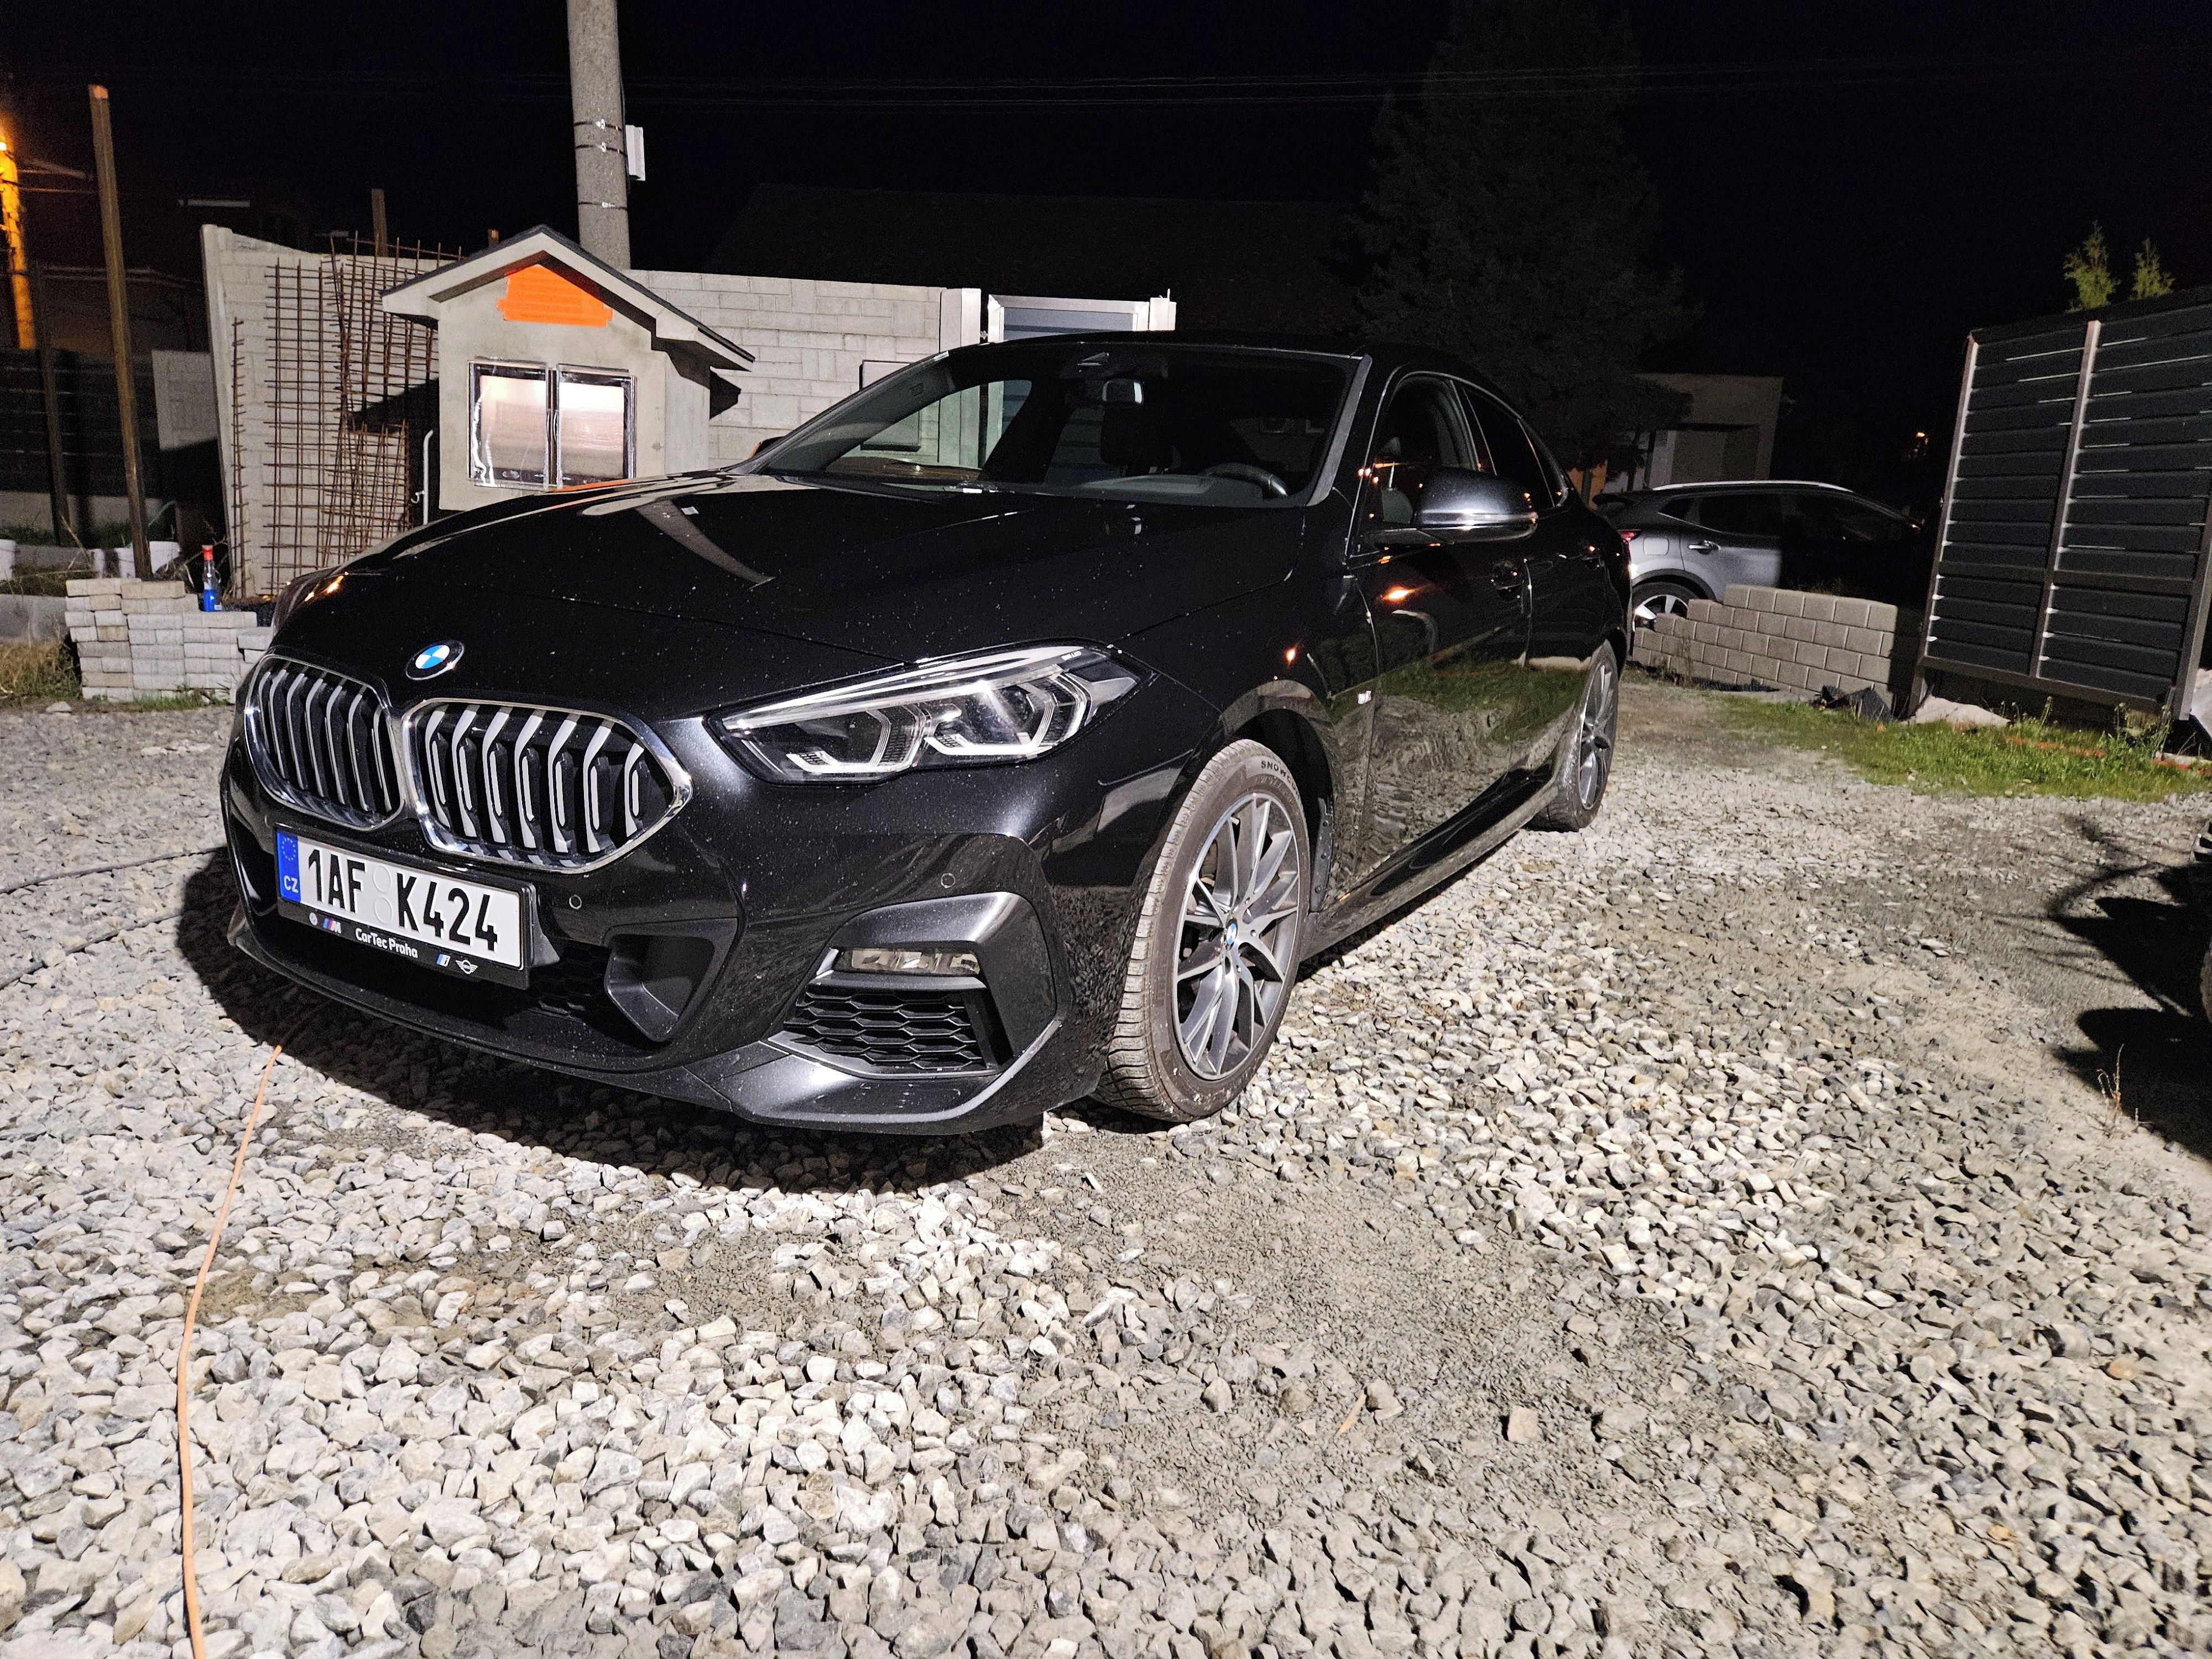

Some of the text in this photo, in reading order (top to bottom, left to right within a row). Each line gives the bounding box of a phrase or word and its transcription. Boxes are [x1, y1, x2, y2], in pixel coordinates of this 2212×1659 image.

[283, 875, 299, 894] CZ
[308, 849, 498, 951] 1AF K424
[355, 927, 419, 959] CarTec Praha
